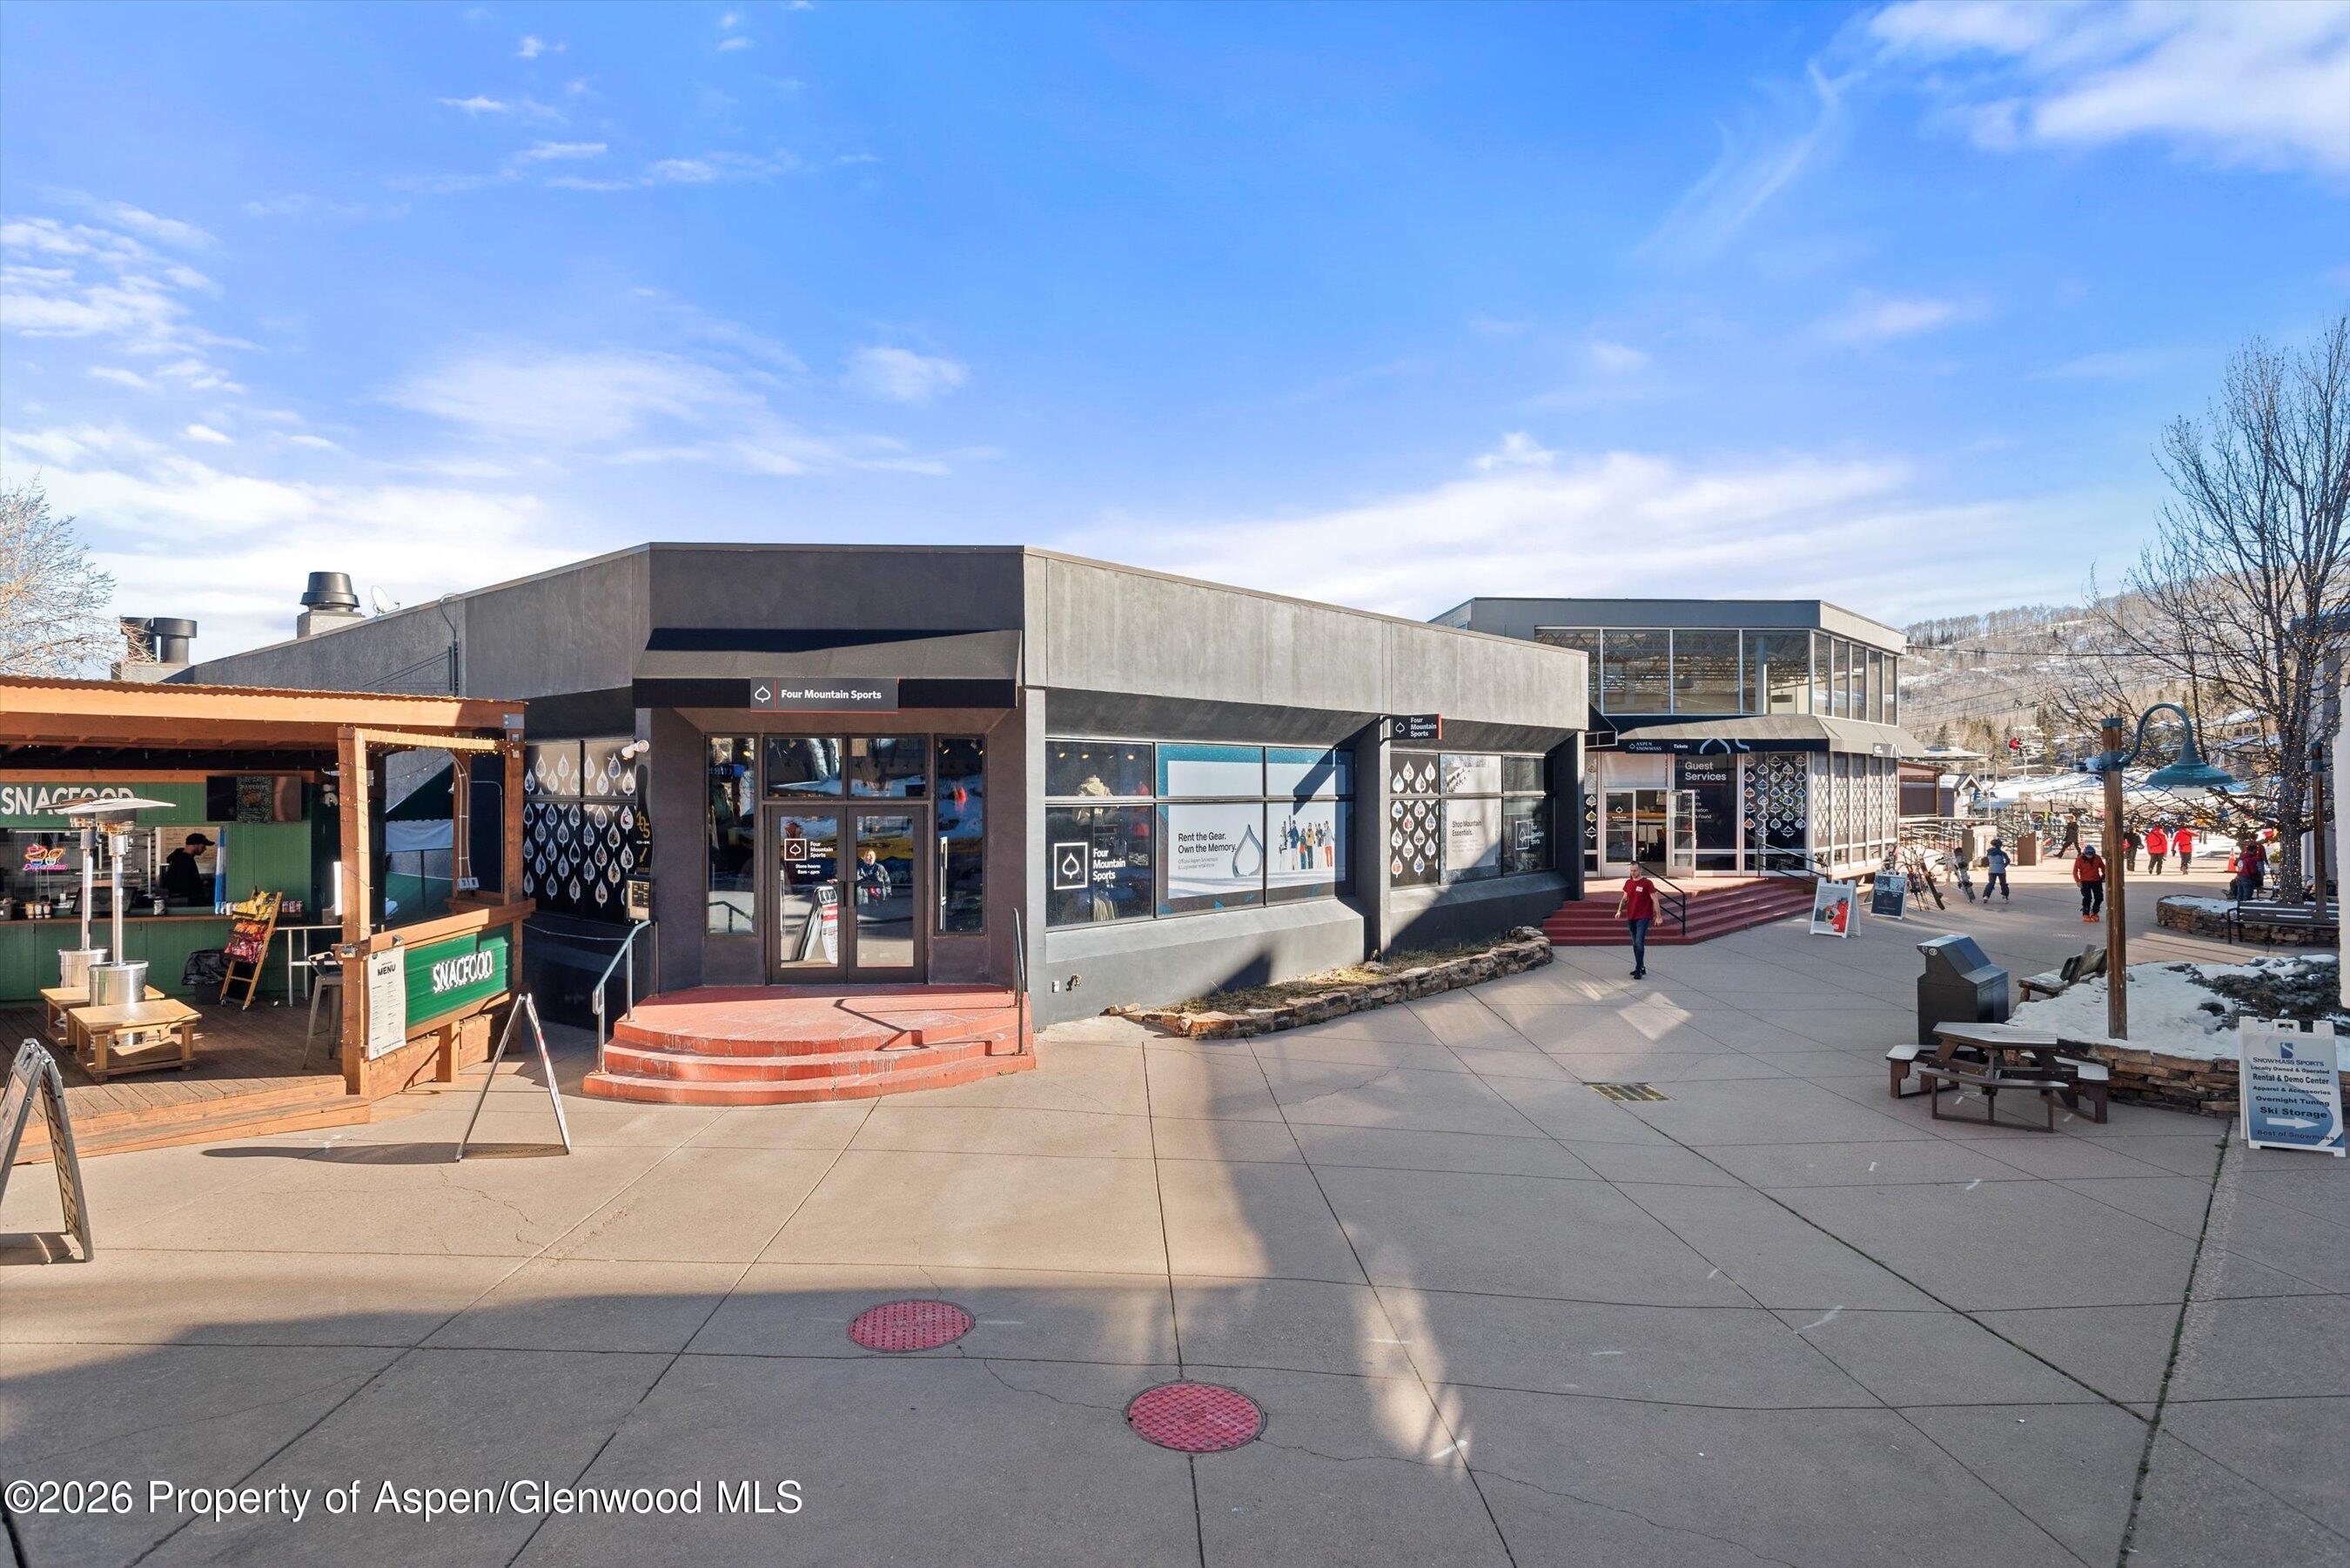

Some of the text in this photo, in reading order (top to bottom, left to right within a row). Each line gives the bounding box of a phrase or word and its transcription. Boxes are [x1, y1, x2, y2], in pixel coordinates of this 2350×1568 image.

[781, 689, 883, 700] Four Mountain Sports
[1685, 761, 1714, 770] Guest
[1685, 772, 1727, 781] Services
[1178, 831, 1226, 842] Rent the Gear.
[1093, 848, 1109, 858] Four
[1178, 842, 1237, 854] Own the Memory.
[1093, 859, 1125, 870] Mountain
[1093, 870, 1115, 881] Sports
[377, 963, 396, 976] MENU
[433, 950, 494, 994] SNACFOOD
[2253, 1073, 2275, 1082] Rental
[2259, 1106, 2328, 1119] Ski Storage
[2289, 1132, 2334, 1141] Snowmass
